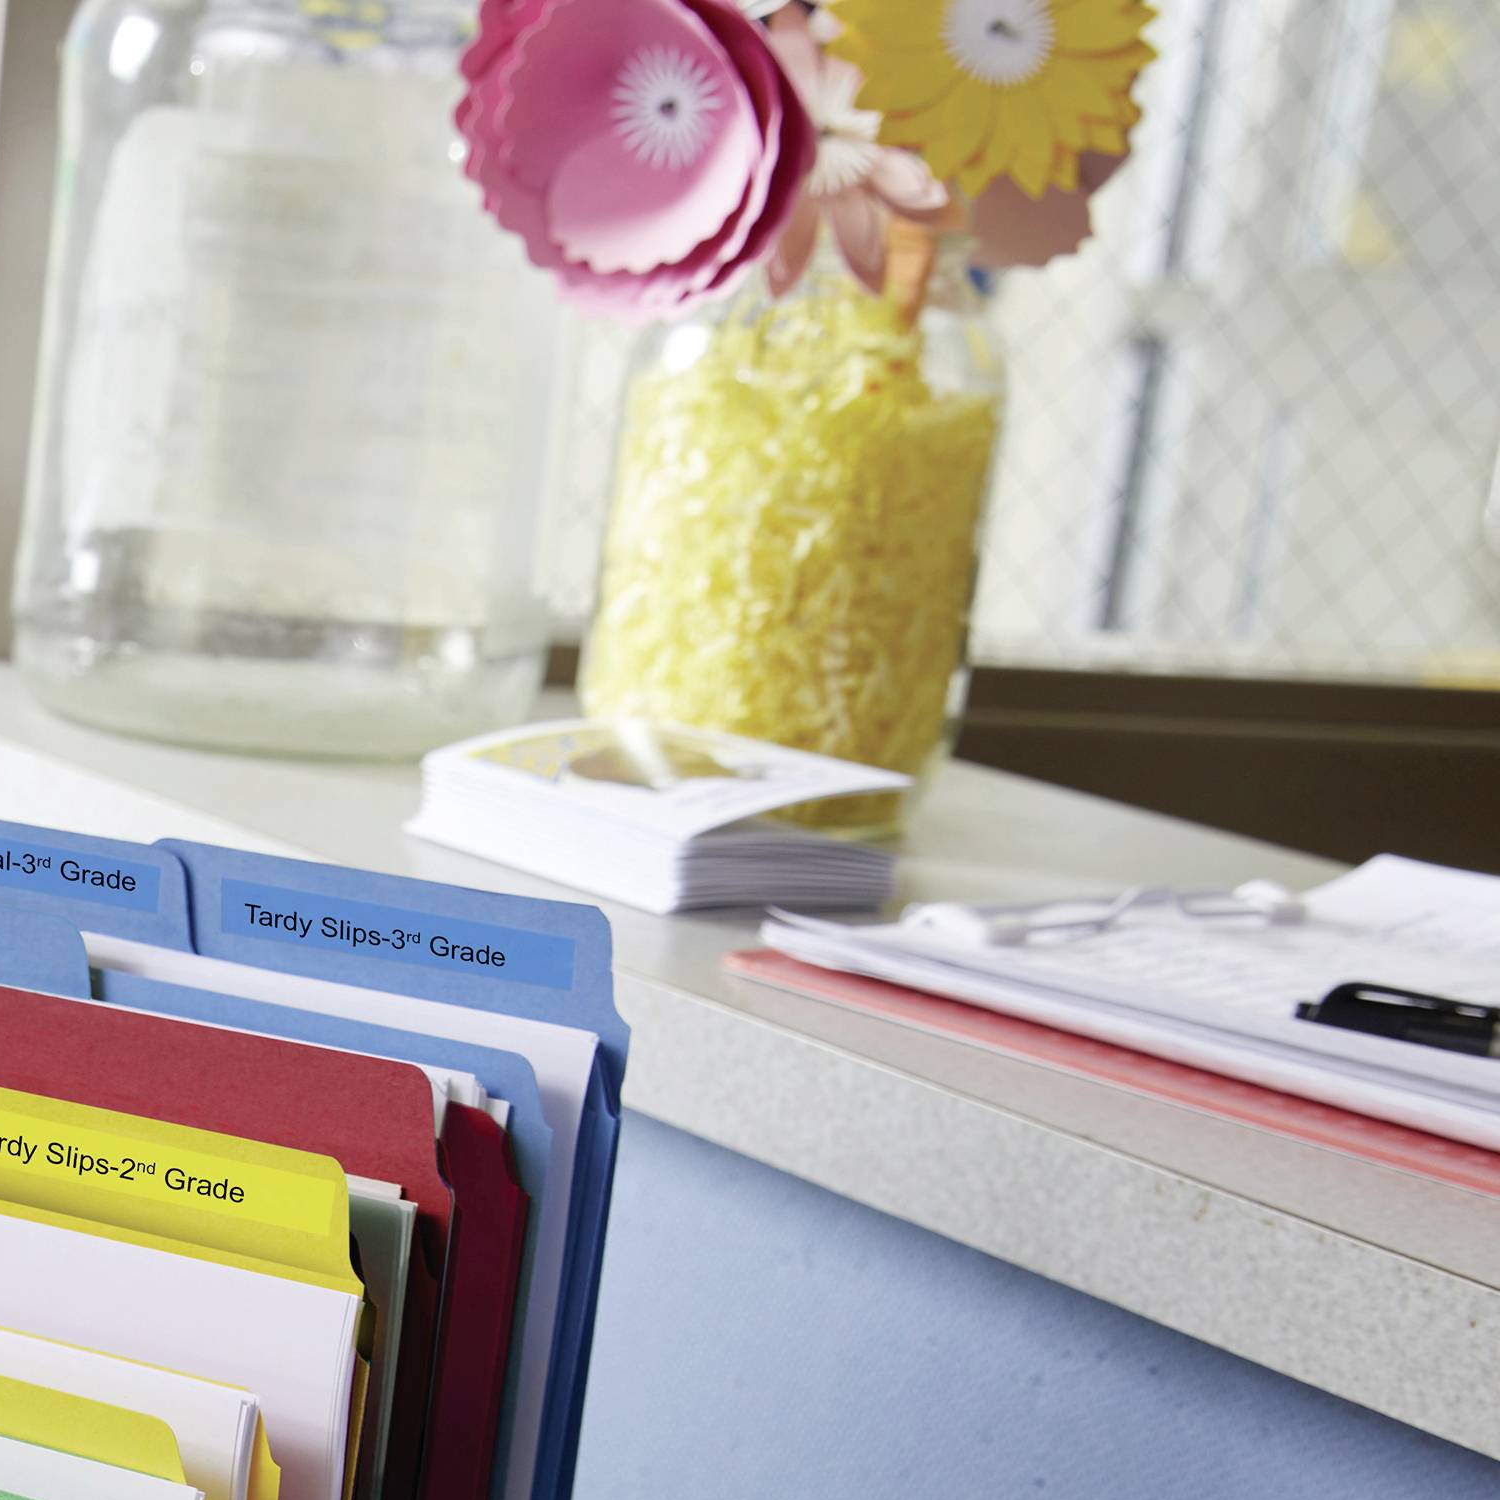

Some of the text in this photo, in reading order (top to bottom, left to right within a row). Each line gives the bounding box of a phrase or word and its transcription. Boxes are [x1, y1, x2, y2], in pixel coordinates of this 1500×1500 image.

[60, 860, 136, 892] Grade
[244, 903, 313, 939] Tardy
[429, 935, 506, 967] Grade
[164, 1167, 245, 1204] Grade
